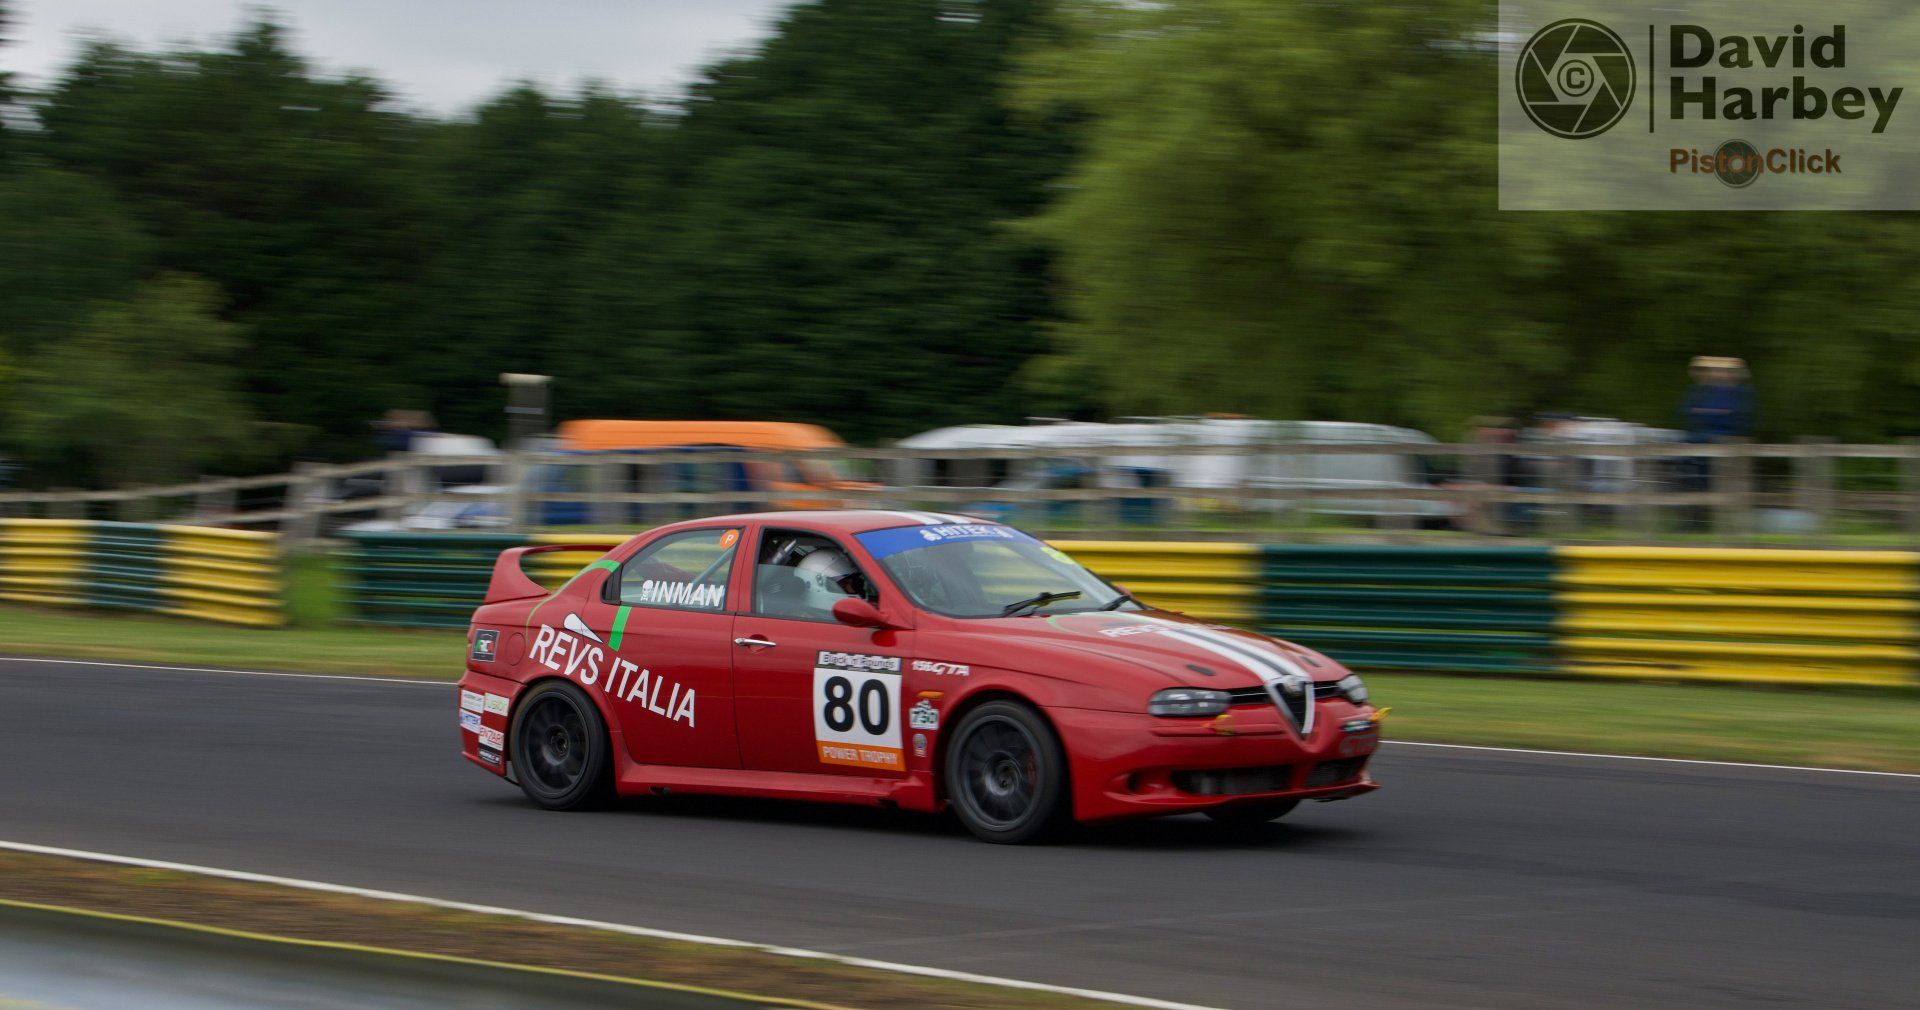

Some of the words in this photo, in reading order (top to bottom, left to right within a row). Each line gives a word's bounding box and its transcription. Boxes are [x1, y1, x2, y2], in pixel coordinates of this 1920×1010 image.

[650, 580, 724, 607] INMAN
[529, 623, 604, 685] REVS
[605, 656, 696, 728] ITALIA
[823, 675, 890, 736] 80
[822, 746, 859, 761] POWER
